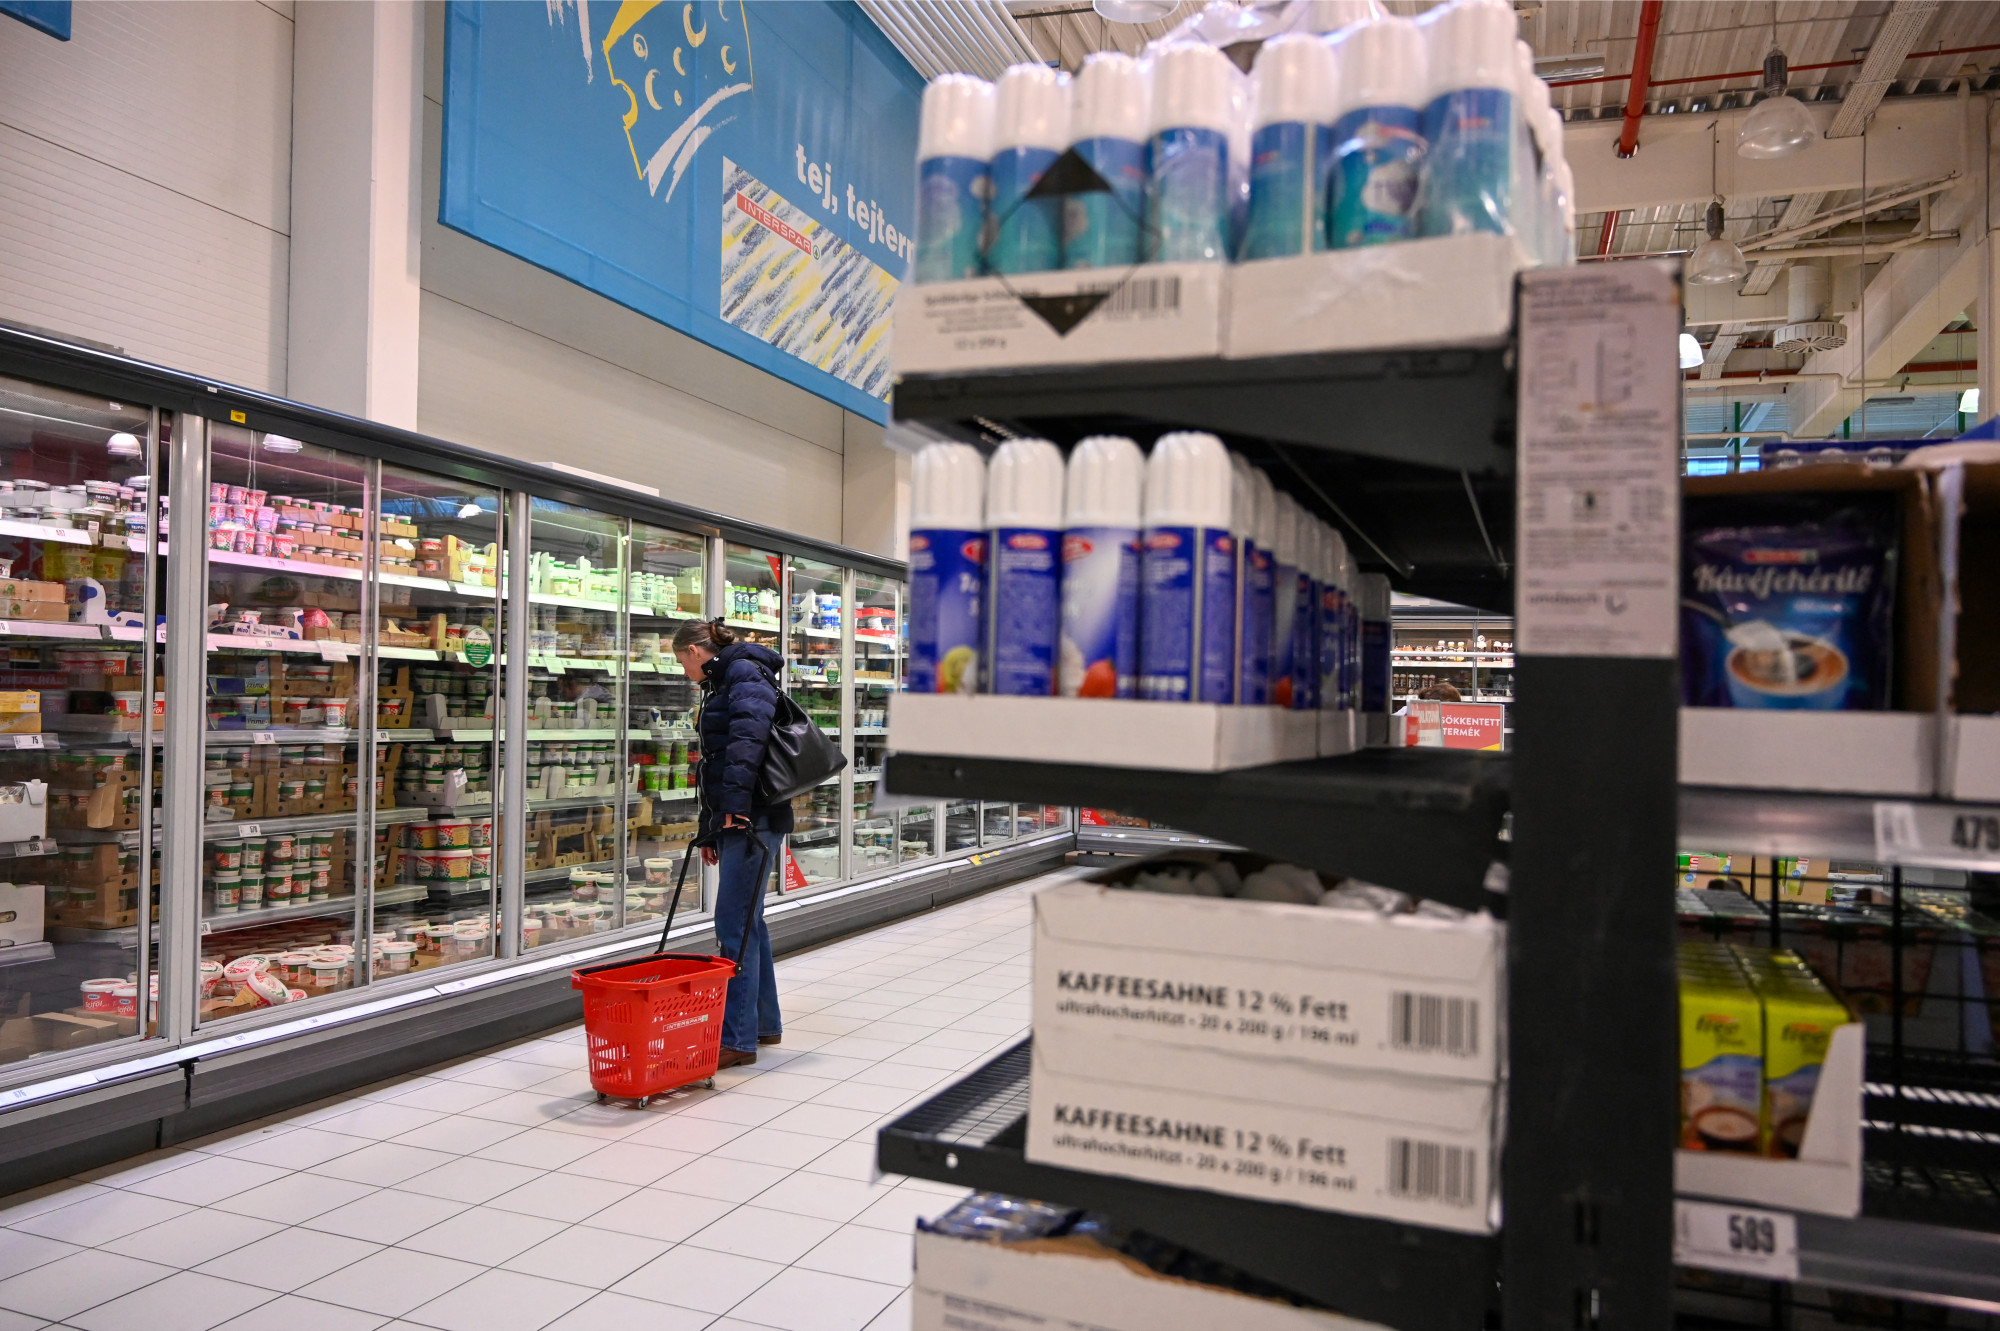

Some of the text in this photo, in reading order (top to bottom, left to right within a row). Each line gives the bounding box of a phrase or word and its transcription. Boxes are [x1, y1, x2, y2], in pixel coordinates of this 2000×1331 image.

[796, 143, 838, 215] tej,
[743, 198, 811, 253] INTERSPAR
[1442, 726, 1481, 737] TERMÉK
[1057, 970, 1349, 1022] KAFFEESAHNE 12 % Fett
[1054, 1104, 1347, 1167] KAFFEESAHNE 12 % Fett
